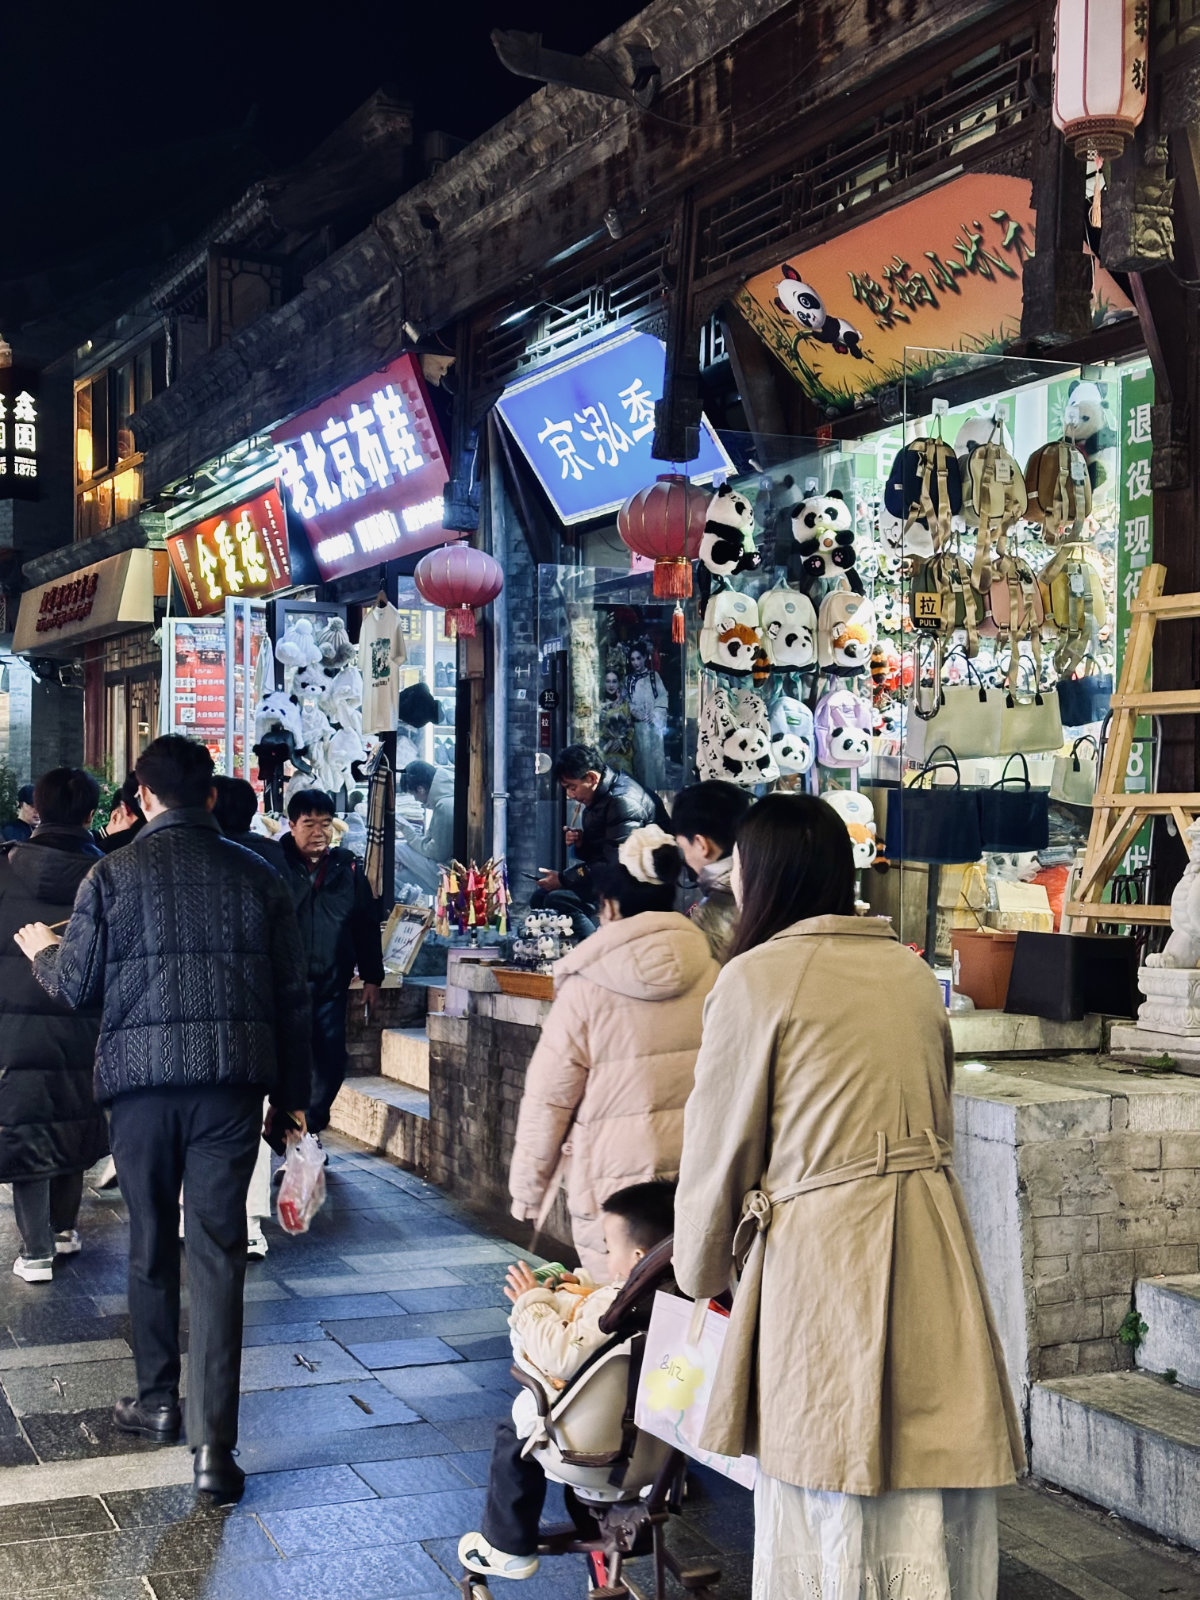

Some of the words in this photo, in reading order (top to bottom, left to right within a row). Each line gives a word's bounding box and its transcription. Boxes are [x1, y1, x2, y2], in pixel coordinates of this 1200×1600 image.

[271, 384, 424, 519] 老北京布鞋
[13, 462, 37, 477] 1875
[919, 595, 937, 616] 拉
[919, 619, 937, 627] PULL
[544, 691, 555, 702] 拉
